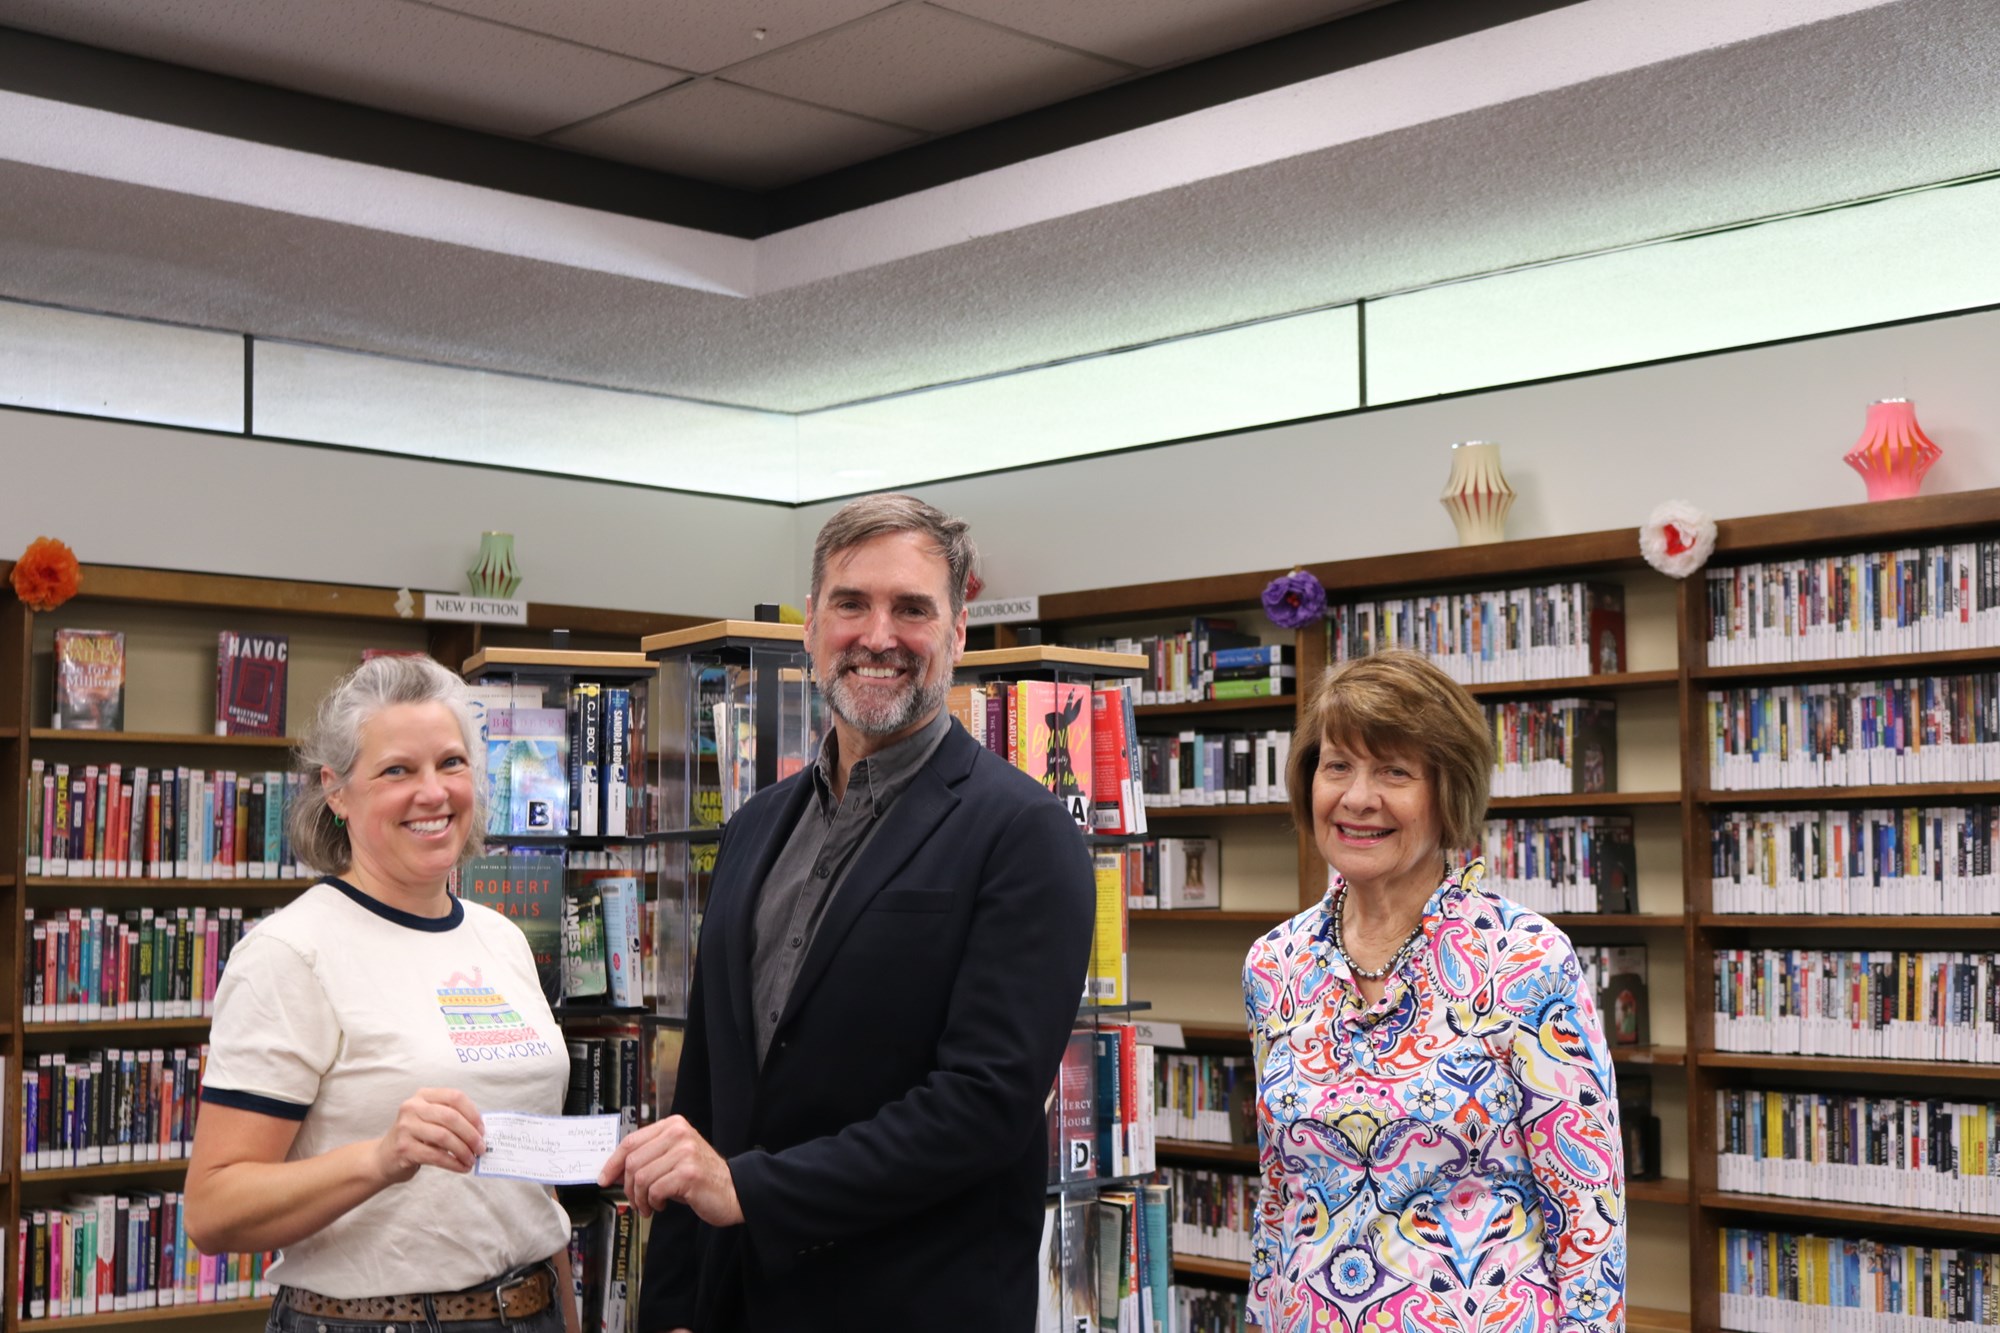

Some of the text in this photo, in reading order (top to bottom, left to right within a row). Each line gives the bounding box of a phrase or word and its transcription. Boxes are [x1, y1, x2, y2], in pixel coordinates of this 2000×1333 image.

[436, 599, 519, 616] NEW FICTION
[968, 601, 1031, 619] AUDIOBOOKS
[229, 636, 288, 662] HAVOC
[613, 709, 623, 742] SANDRA
[1009, 709, 1018, 748] STARTUP
[586, 726, 596, 753] BOX
[56, 791, 68, 830] CLANCY
[528, 802, 550, 827] B
[1071, 797, 1086, 823] A
[474, 879, 550, 895] ROBERT
[567, 896, 581, 954] JAMES
[456, 1041, 553, 1063] BOOKWORM
[592, 1047, 601, 1107] TESS GERRITS
[1055, 1099, 1092, 1112] MERCY
[1055, 1115, 1092, 1128] HOUSE
[1074, 1142, 1089, 1169] D
[1896, 1133, 1904, 1169] COLLAPS
[619, 1214, 630, 1237] LADY
[616, 1258, 627, 1281] LAKE
[1948, 1287, 1957, 1314] MANKIND
[1956, 1296, 1965, 1314] CRUDE
[1982, 1294, 1991, 1320] STRAY
